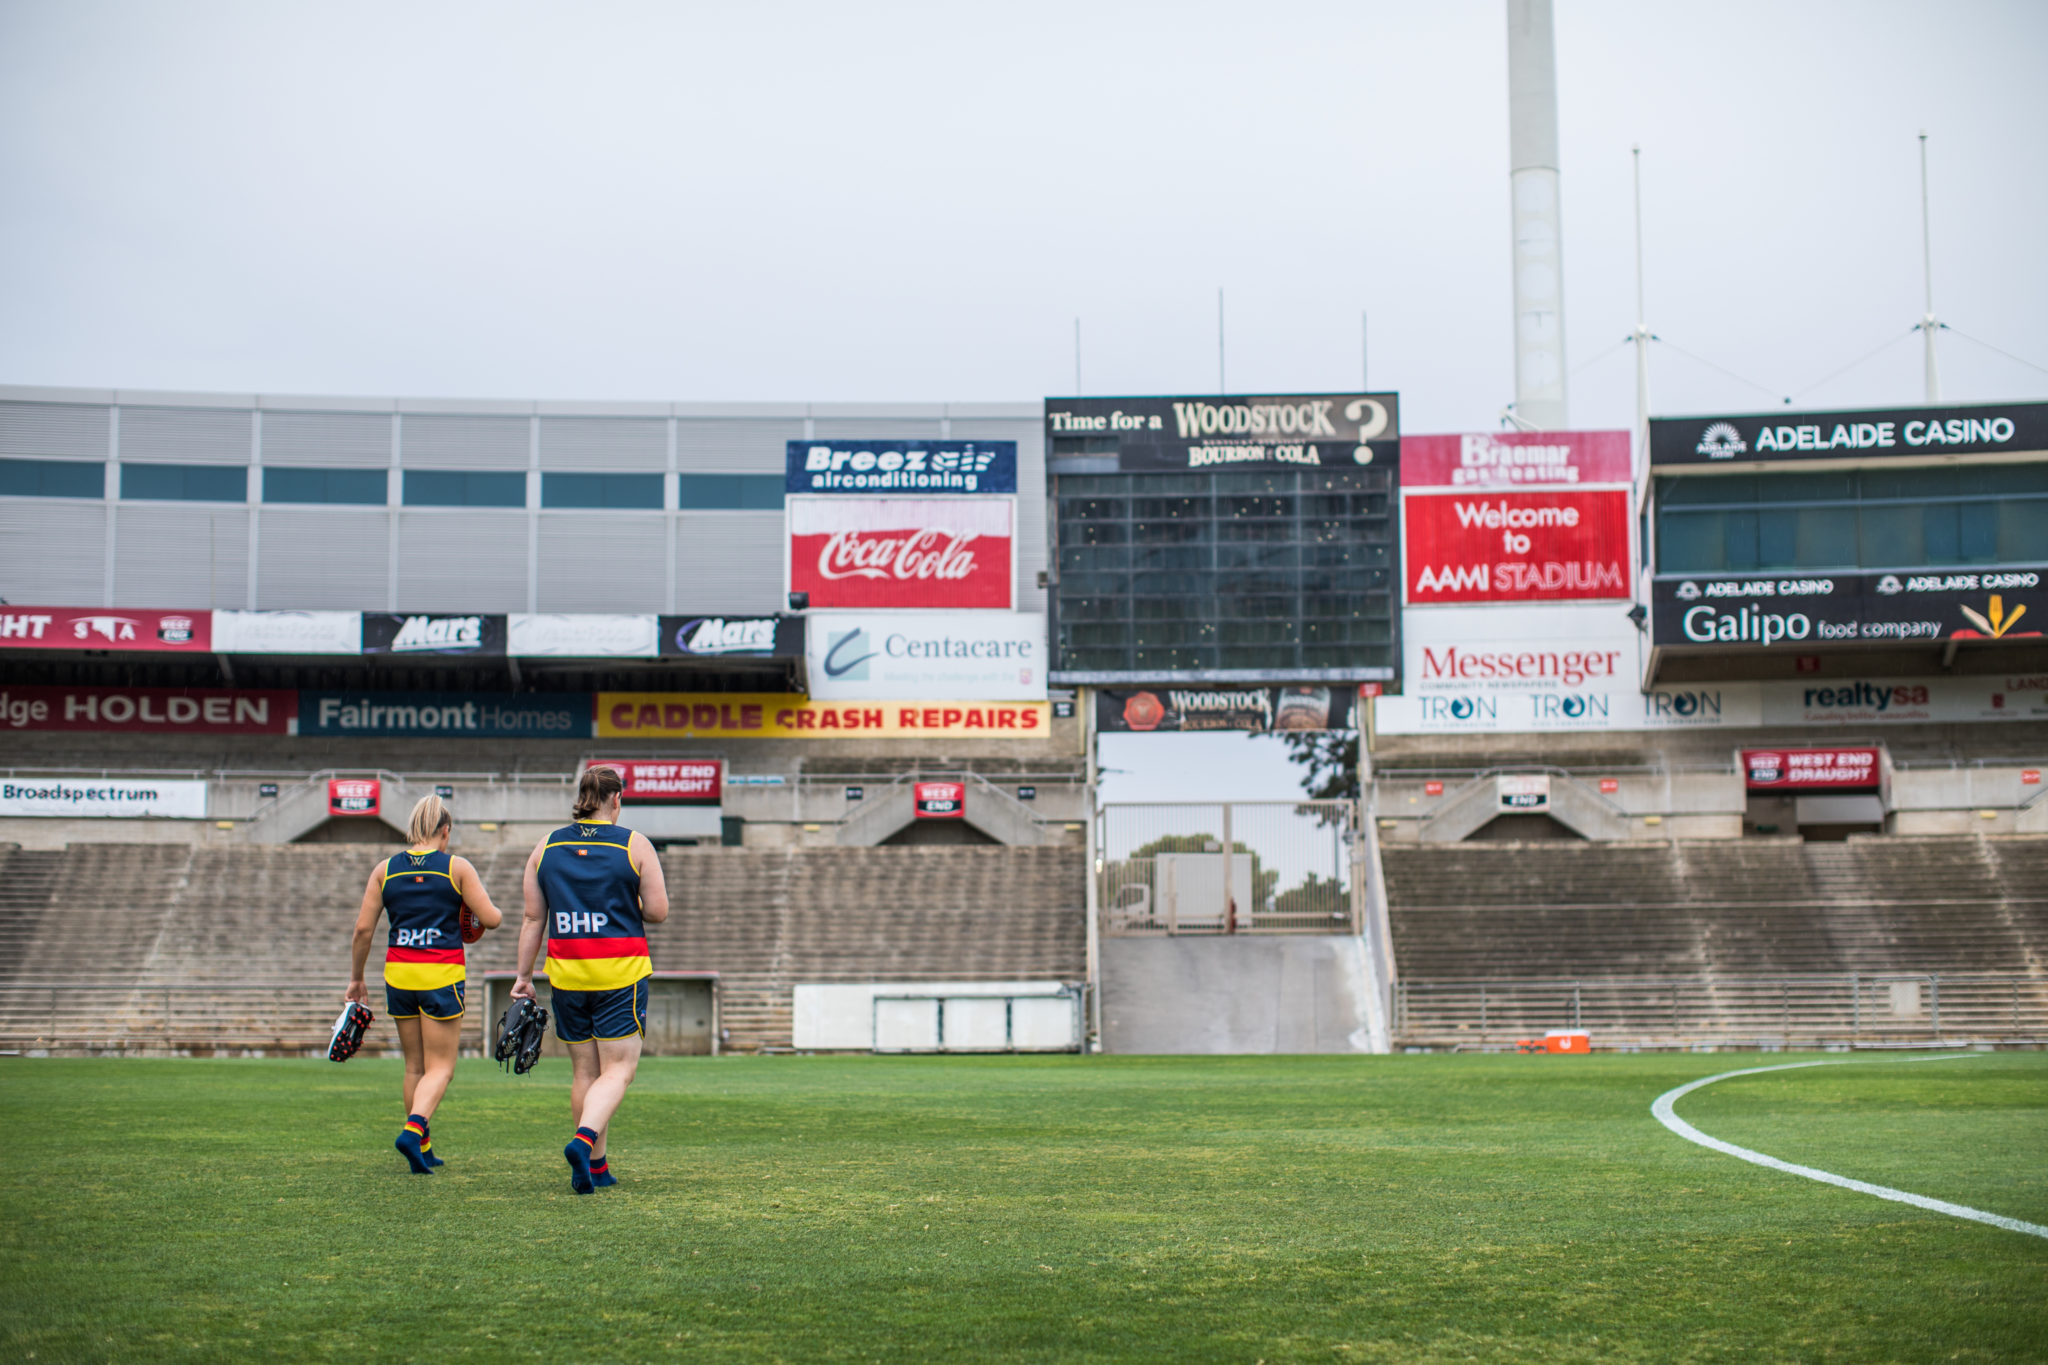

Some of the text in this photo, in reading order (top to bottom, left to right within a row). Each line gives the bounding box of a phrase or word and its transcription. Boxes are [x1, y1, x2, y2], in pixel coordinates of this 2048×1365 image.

[1050, 411, 1107, 430] Time
[1110, 411, 1145, 430] for
[1149, 415, 1163, 429] a
[1173, 401, 1336, 438] WOODSTOCK
[1755, 417, 2015, 452] ADELAIDE CASINO
[1188, 445, 1321, 468] BOURBON COLA
[1461, 434, 1571, 467] Braemar
[811, 471, 979, 491] airconditioning
[1454, 500, 1580, 529] Welcome
[1503, 529, 1531, 554] to
[1416, 561, 1623, 593] AAMI STADIUM
[1705, 579, 1834, 598] ADELAIDE CASINO
[1906, 573, 2039, 592] ADELAIDE CASINO
[0, 614, 52, 639] HT
[391, 615, 481, 648] Mars
[688, 617, 776, 649] Mars
[1683, 602, 1943, 647] Galipo food company
[885, 633, 1033, 659] Centacare
[1421, 646, 1621, 687] Messenger
[1804, 681, 1929, 711] realtysa
[65, 695, 268, 724] HOLDEN
[319, 699, 572, 730] Fairmont Homes
[610, 703, 763, 730] CADDLE
[775, 708, 883, 730] CRASH
[899, 708, 1039, 729] REPAIRS
[633, 765, 677, 778] WEST
[680, 765, 715, 778] END
[1788, 752, 1873, 767] WEST END
[634, 779, 713, 792] DRAUGHT
[1789, 767, 1871, 782] DRAUGHT
[3, 784, 157, 803] Broadspectrum
[336, 784, 373, 796] WEST
[921, 788, 957, 800] WEST
[341, 798, 369, 809] END
[926, 800, 953, 811] END
[556, 911, 609, 934] BHP
[396, 928, 442, 946] BHP
